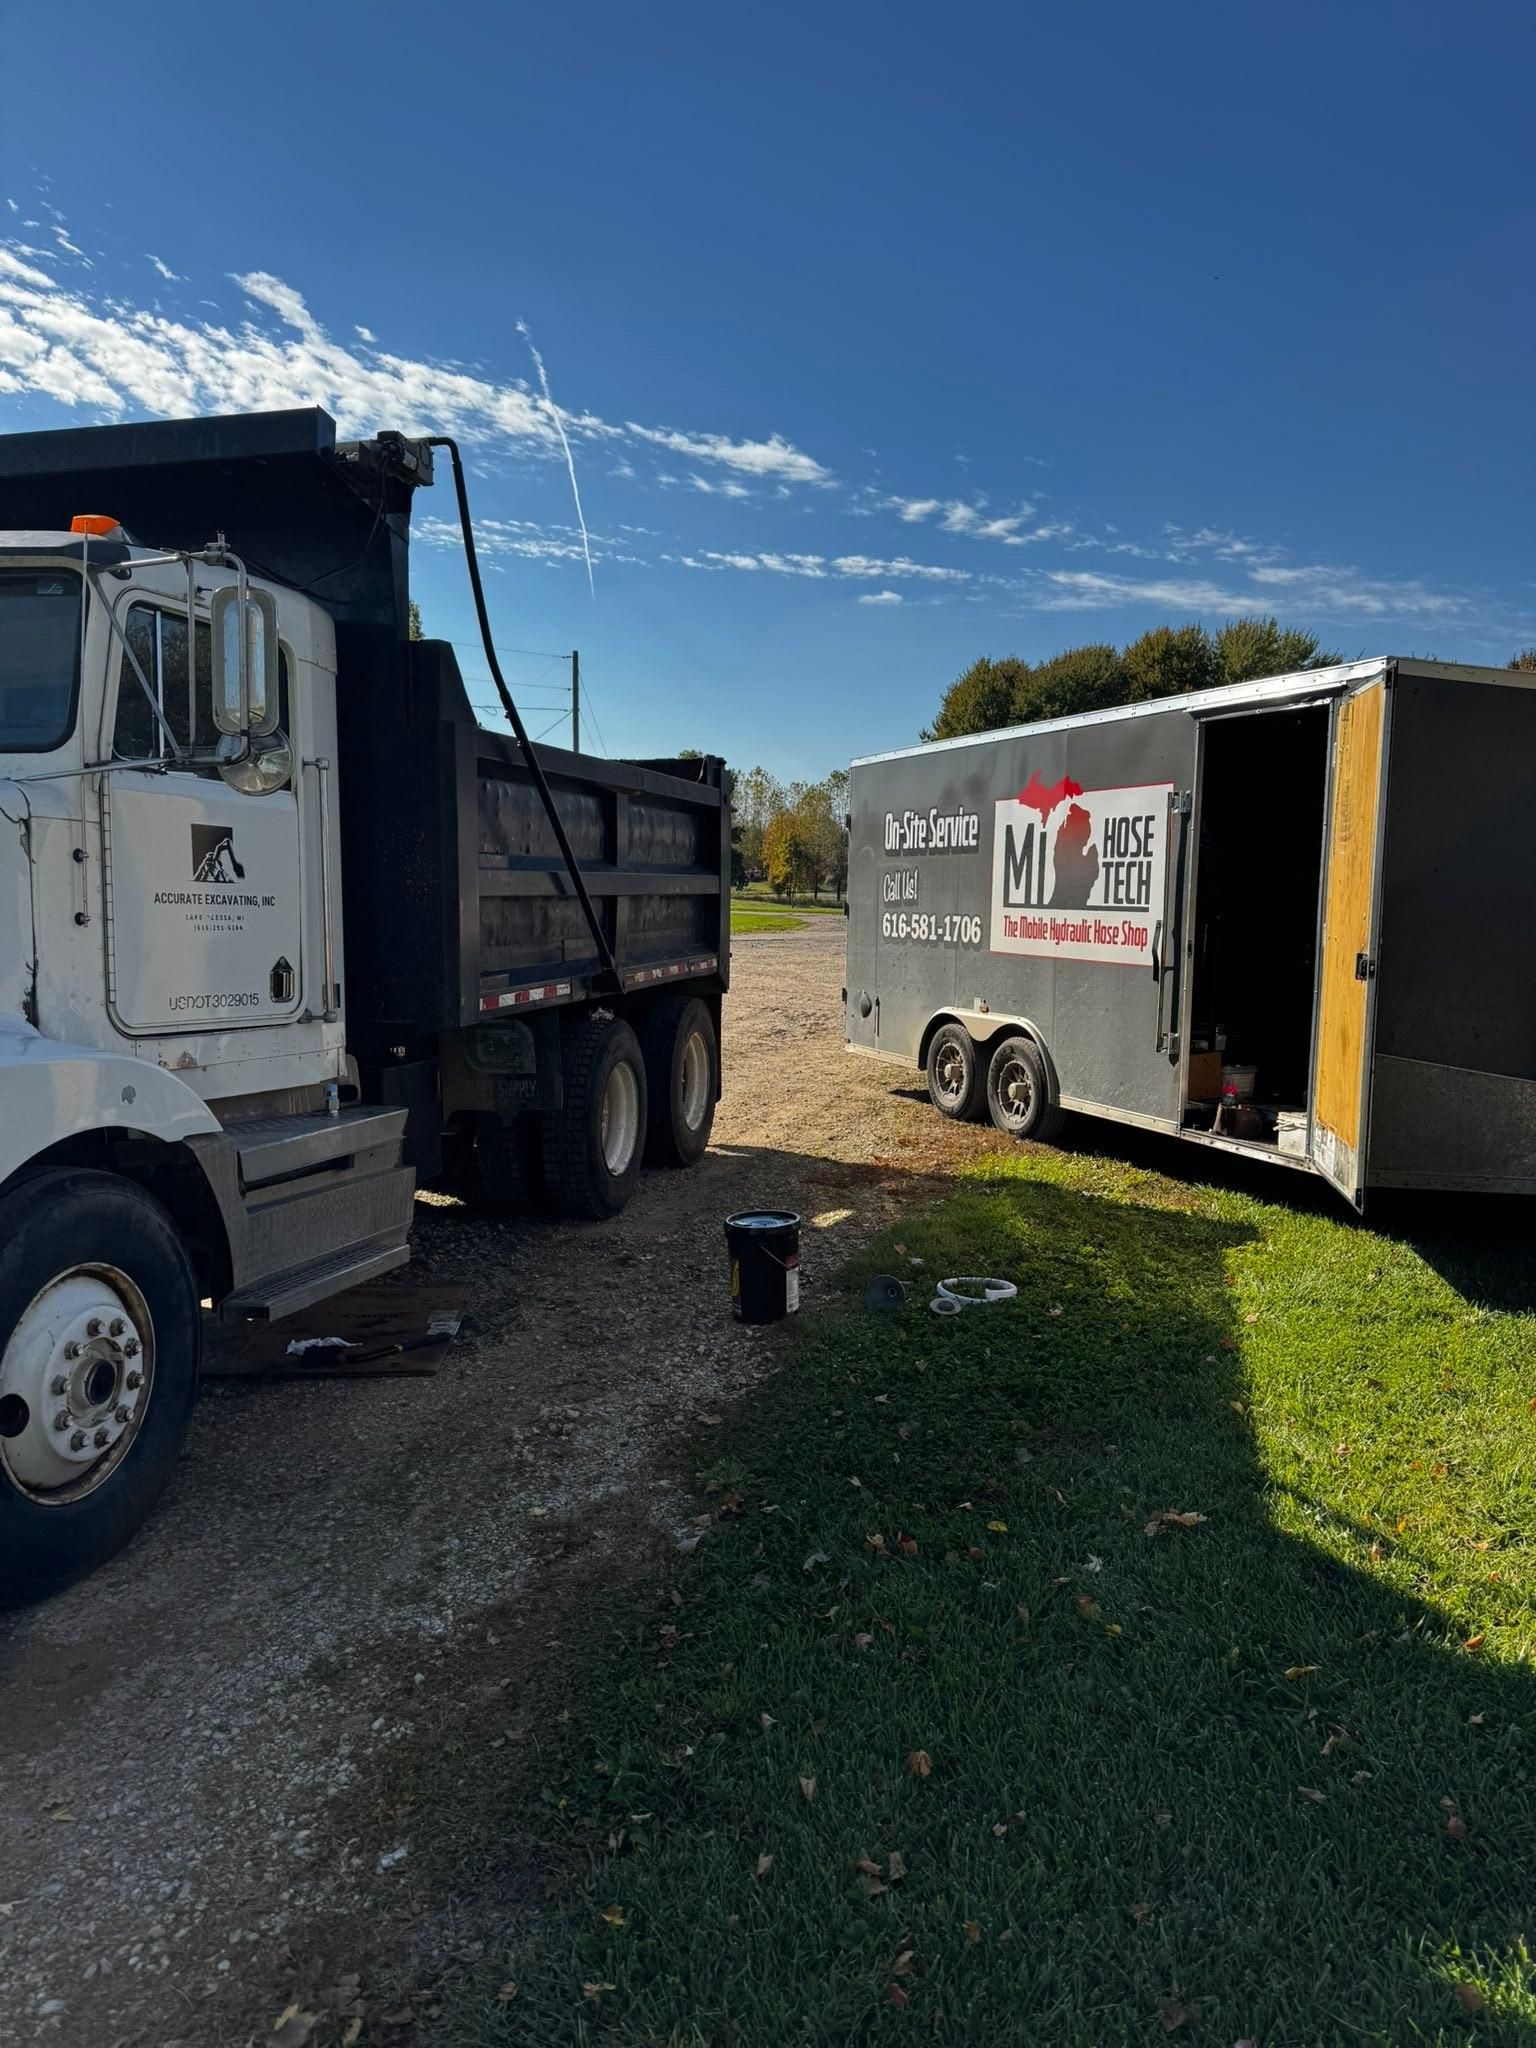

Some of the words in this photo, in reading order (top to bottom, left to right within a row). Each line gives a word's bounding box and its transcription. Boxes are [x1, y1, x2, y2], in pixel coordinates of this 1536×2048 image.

[884, 811, 927, 850] On-Site
[928, 806, 978, 848] Service
[1103, 815, 1155, 858] HOSE
[1003, 823, 1047, 905] MI
[1102, 860, 1152, 905] TECH
[154, 892, 203, 904] ACCURATE
[205, 894, 260, 908] EXCAVATING,
[262, 896, 275, 906] INC
[883, 871, 900, 902] Call
[902, 868, 918, 900] Us!
[882, 912, 981, 943] 616-581-1706
[1003, 915, 1018, 938] The
[1019, 916, 1048, 940] Mobile
[1049, 917, 1092, 945] Hydraulic
[1093, 919, 1119, 945] Hose
[1120, 920, 1149, 952] Shop
[169, 993, 260, 1010] USDOT3029015
